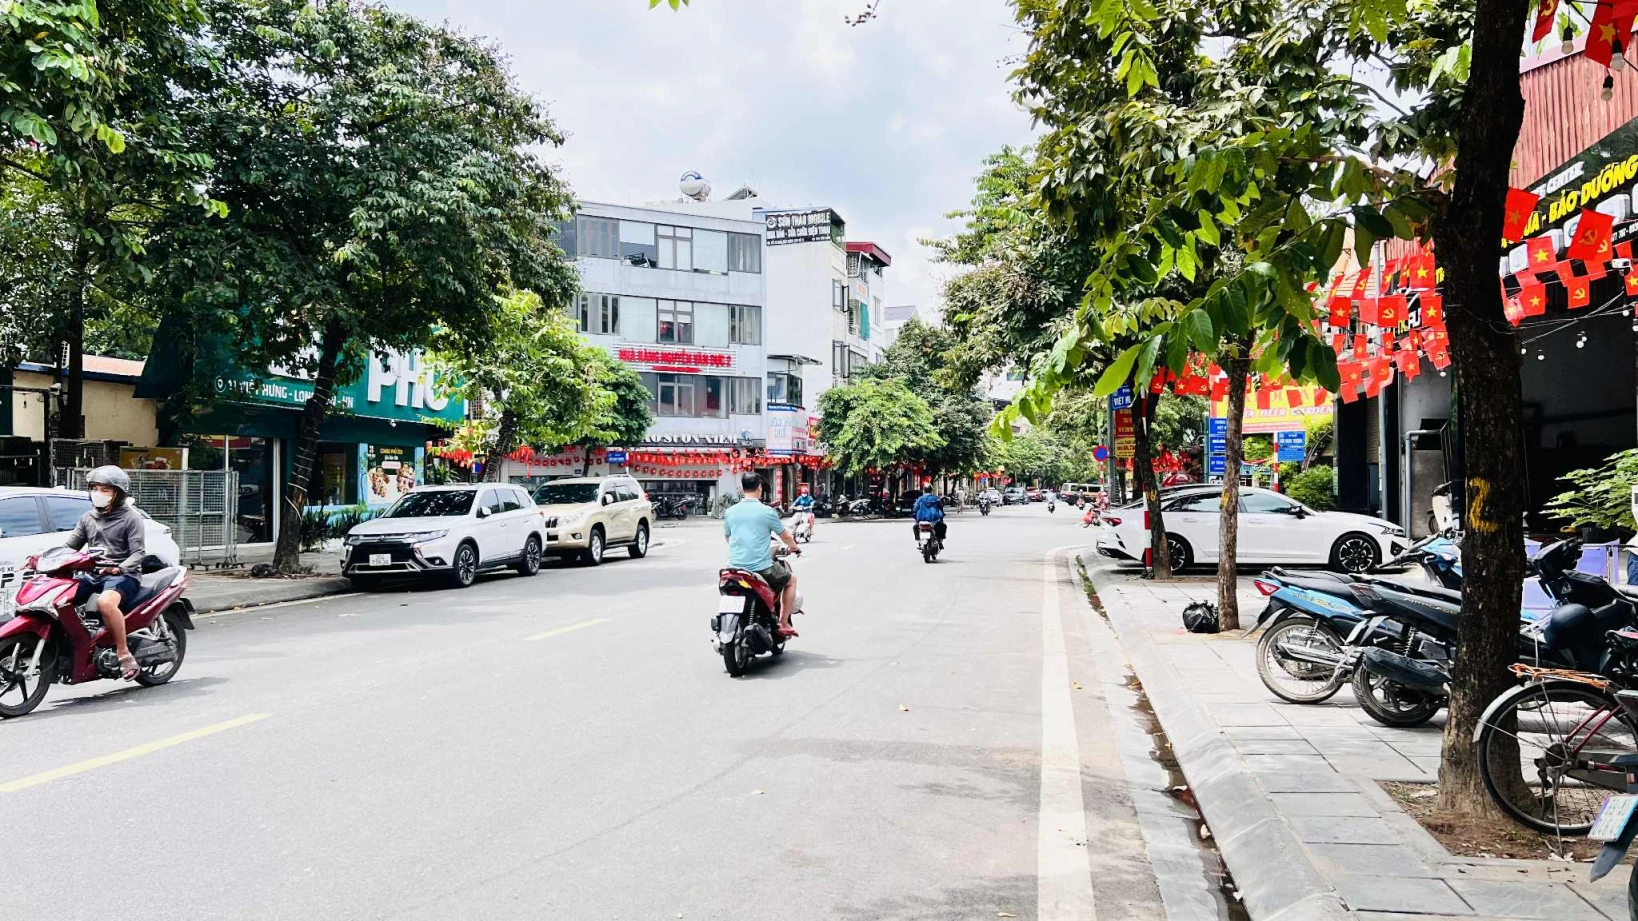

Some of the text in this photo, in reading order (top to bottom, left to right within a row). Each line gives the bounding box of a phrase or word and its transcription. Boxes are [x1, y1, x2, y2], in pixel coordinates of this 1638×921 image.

[1548, 190, 1578, 224] BẢO
[1580, 153, 1638, 206] DƯỠNG
[262, 383, 288, 399] HƯNG
